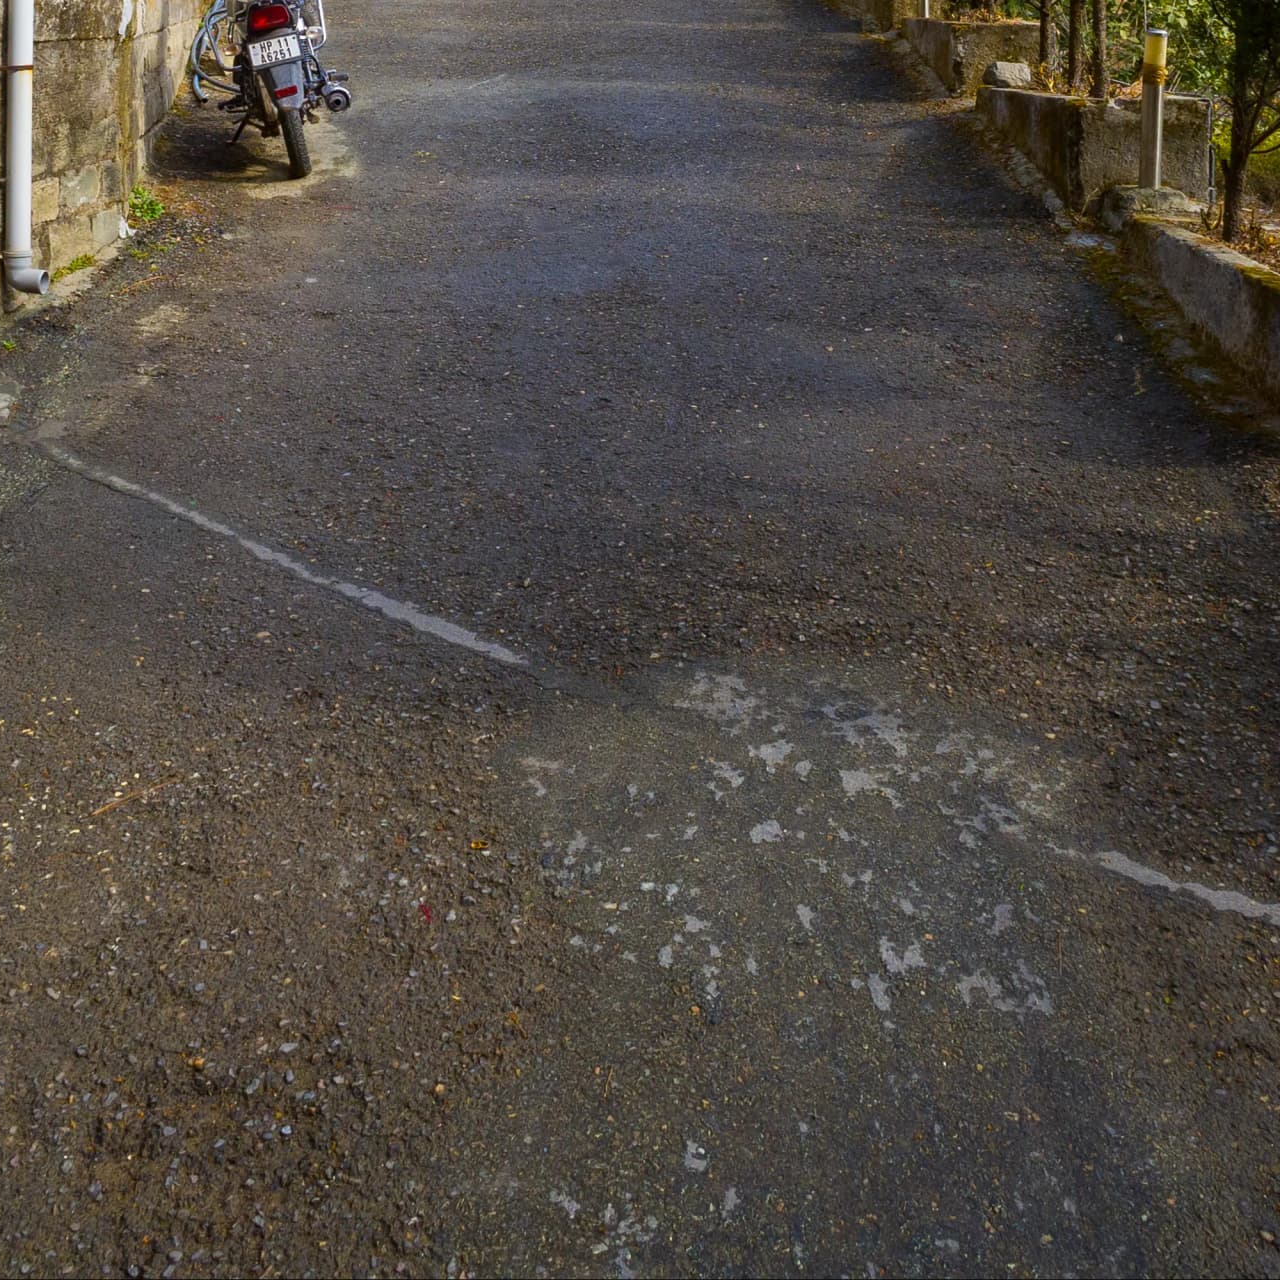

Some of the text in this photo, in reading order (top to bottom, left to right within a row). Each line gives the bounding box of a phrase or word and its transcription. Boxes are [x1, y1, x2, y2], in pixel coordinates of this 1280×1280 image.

[260, 38, 289, 53] HP 11
[260, 47, 292, 63] A6251
